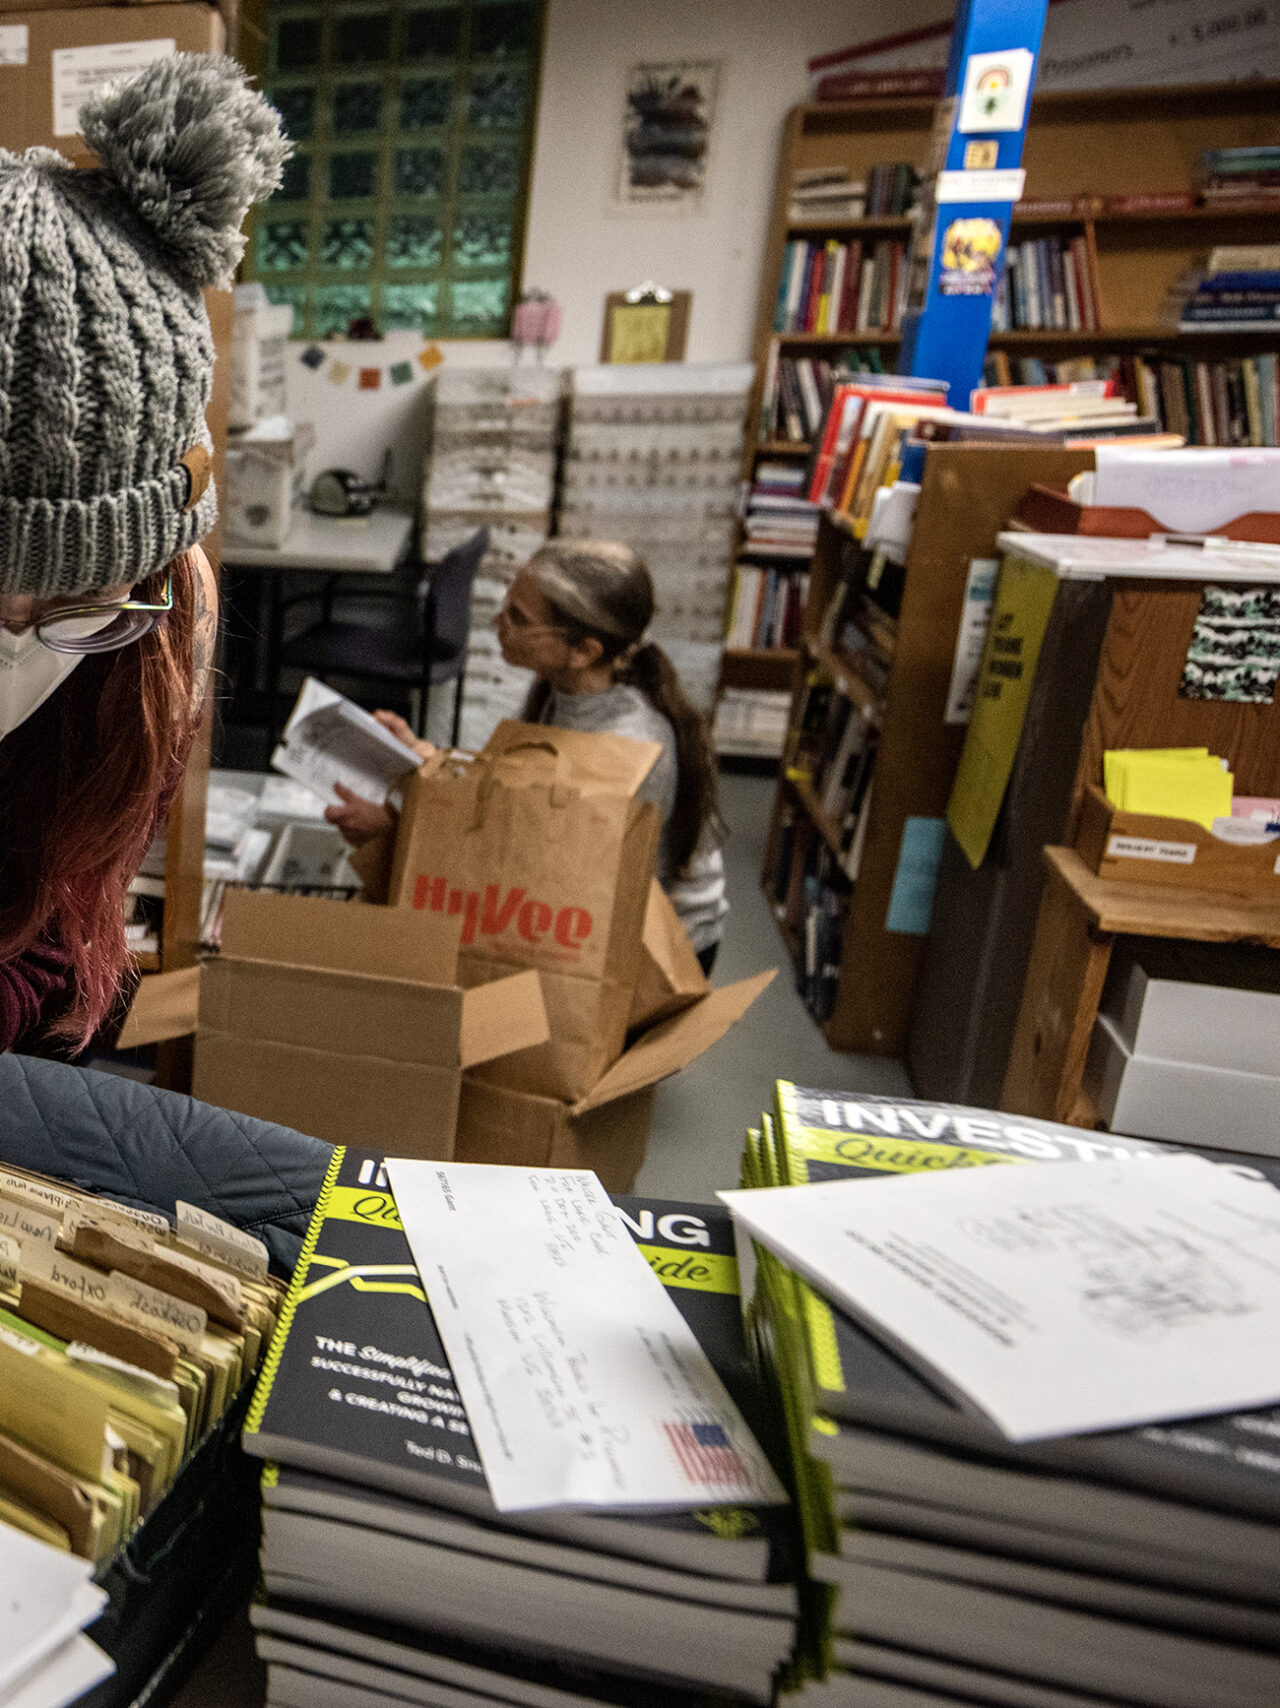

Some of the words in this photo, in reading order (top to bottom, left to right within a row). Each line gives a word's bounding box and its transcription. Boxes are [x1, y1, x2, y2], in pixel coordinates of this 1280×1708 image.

[315, 1335, 358, 1357] THE
[310, 1355, 427, 1392] SUCCESSFULLY
[328, 1387, 343, 1402] &
[344, 1392, 429, 1424] CREATING
[430, 1414, 446, 1430] A
[404, 1439, 435, 1460] Ted
